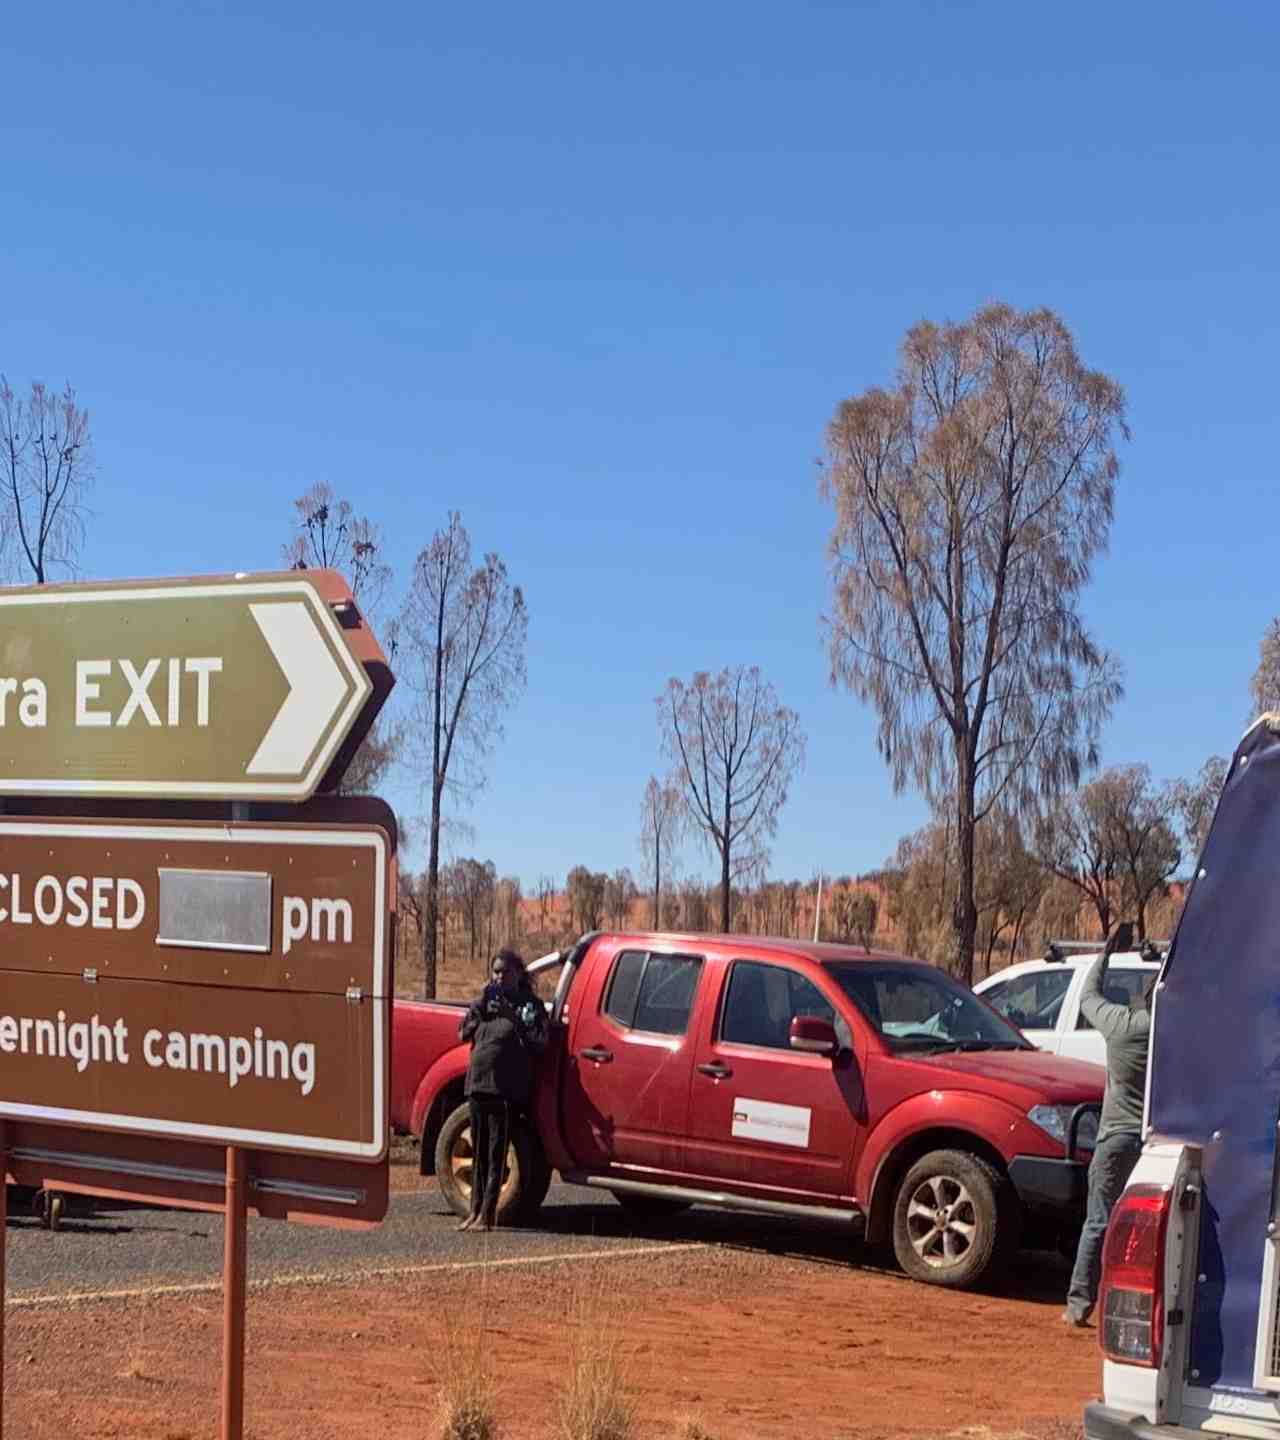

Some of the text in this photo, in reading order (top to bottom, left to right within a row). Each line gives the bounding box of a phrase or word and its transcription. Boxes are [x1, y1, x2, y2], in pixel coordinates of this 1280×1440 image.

[75, 657, 223, 727] EXIT
[283, 897, 352, 954] pm
[144, 1028, 314, 1094] camping
